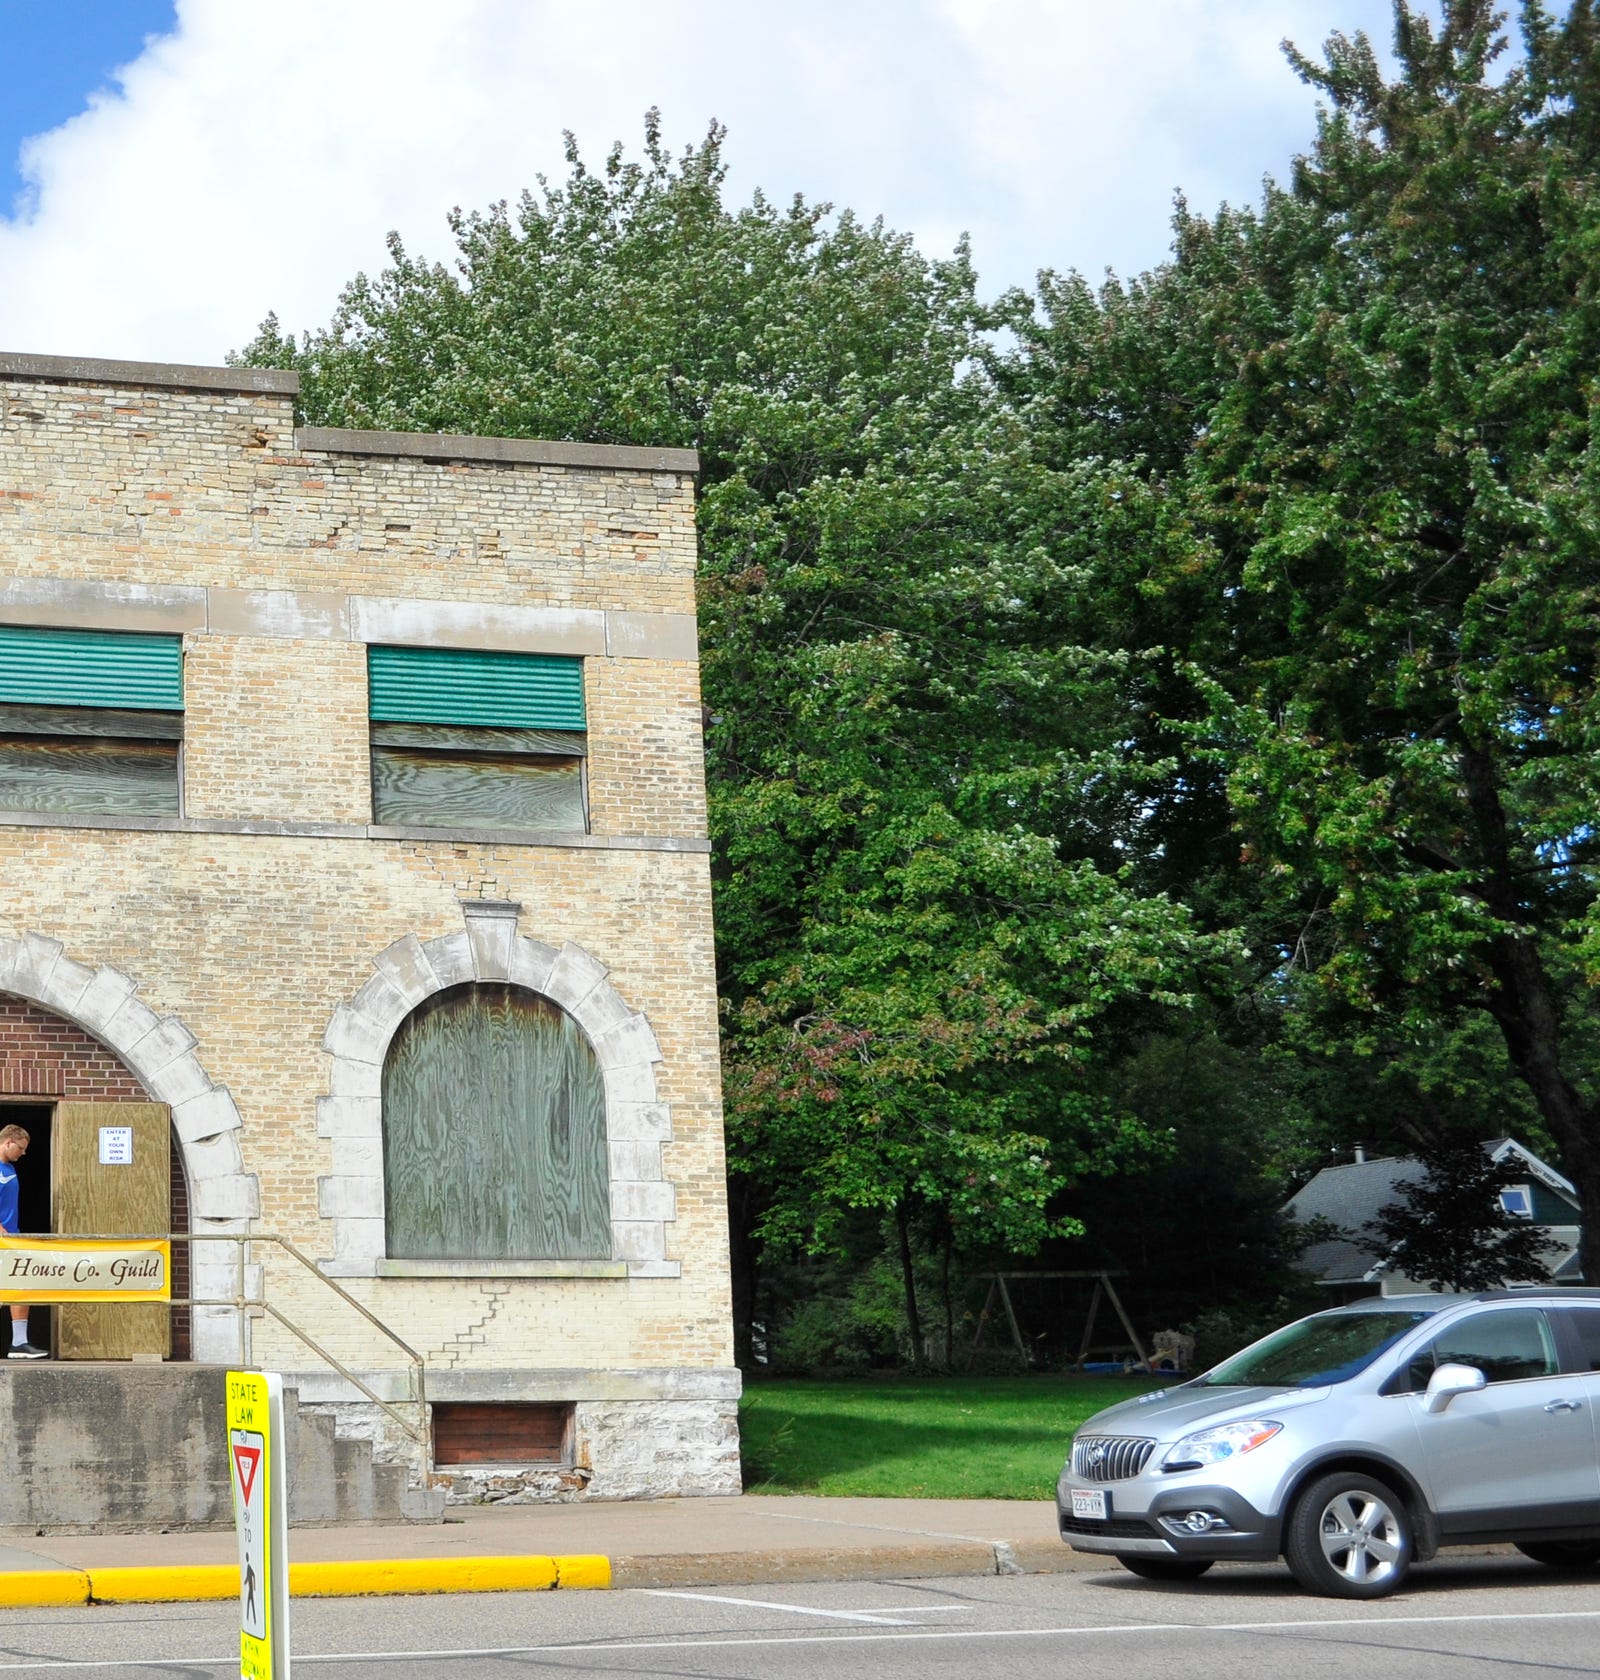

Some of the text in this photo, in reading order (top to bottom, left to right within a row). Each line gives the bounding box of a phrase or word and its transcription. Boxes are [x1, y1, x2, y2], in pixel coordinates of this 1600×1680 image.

[8, 1258, 66, 1277] House
[73, 1258, 100, 1283] Co.
[110, 1258, 160, 1286] Guild
[230, 1382, 258, 1402] STATE
[234, 1406, 254, 1424] LAW
[244, 1528, 252, 1543] TO
